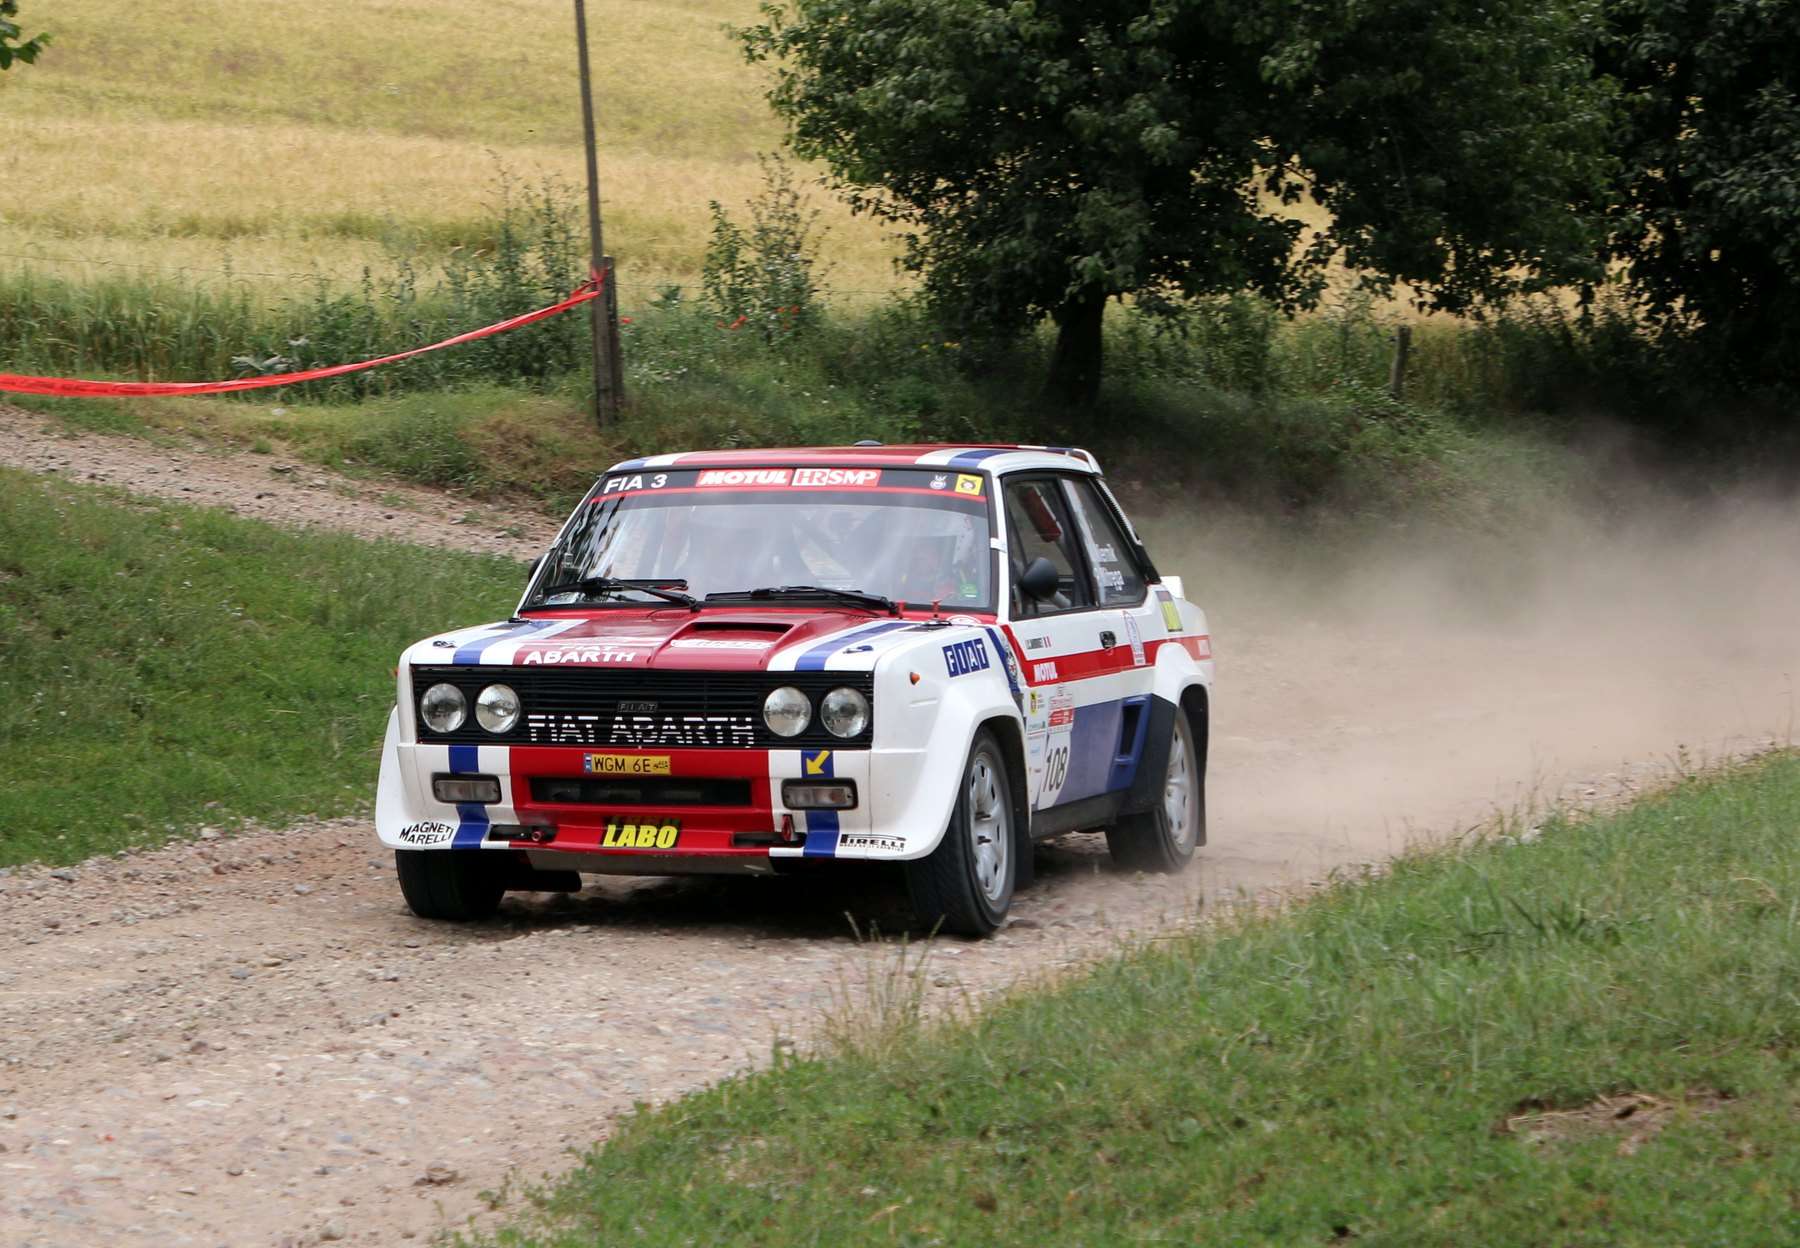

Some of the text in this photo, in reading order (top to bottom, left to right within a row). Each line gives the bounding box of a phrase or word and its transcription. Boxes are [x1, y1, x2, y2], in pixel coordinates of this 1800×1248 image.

[603, 473, 668, 494] FIA 3
[700, 470, 788, 485] MOTUL
[522, 650, 637, 665] ABARTH
[942, 639, 989, 677] FIAT
[528, 715, 754, 745] FIAT ABARTH
[593, 756, 627, 772] WGM
[632, 758, 652, 773] 6E
[1042, 745, 1068, 793] 108
[602, 823, 678, 848] LABO
[840, 834, 906, 849] PIRELLI
